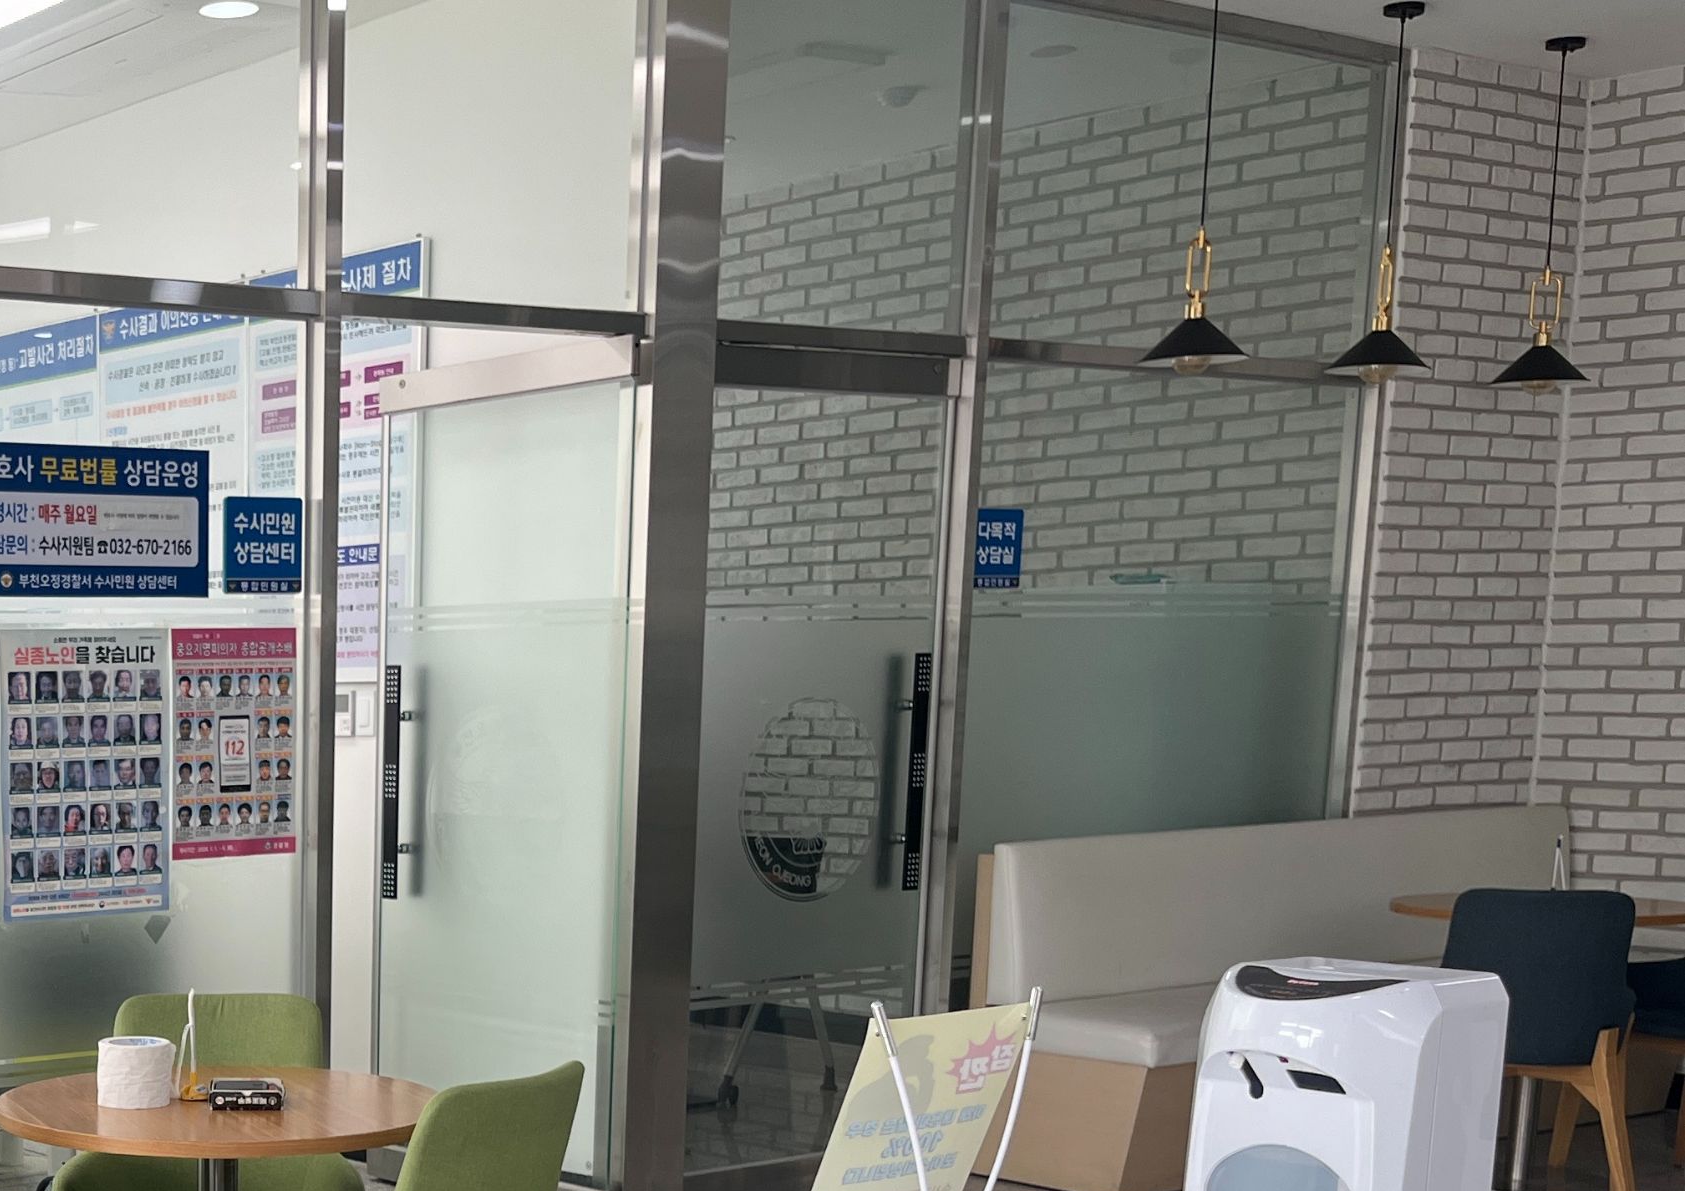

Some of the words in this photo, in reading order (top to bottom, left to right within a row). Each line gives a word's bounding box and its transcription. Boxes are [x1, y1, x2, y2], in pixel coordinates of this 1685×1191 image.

[382, 257, 411, 286] 절차
[119, 311, 157, 340] 수사결과
[57, 333, 94, 362] 처리절차
[40, 457, 117, 485] 무료법률
[124, 459, 199, 489] 상담운영
[38, 505, 61, 524] 매주
[64, 505, 97, 525] 월요일
[234, 512, 295, 535] 수사민원
[978, 522, 1016, 540] 다목적
[39, 536, 94, 556] 수사지원팀
[109, 539, 192, 555] 032-670-2166
[234, 542, 295, 564] 상담센터
[977, 546, 1014, 565] 상담실
[19, 574, 91, 589] 부천오정경찰서
[95, 575, 134, 589] 수사민원
[137, 575, 177, 589] 상담센터
[14, 646, 90, 665] 실종노인을
[96, 645, 155, 664] 찾습니다
[177, 643, 237, 656] 중요지명피의자
[241, 642, 293, 656] 종합공개수배
[225, 740, 245, 755] 112
